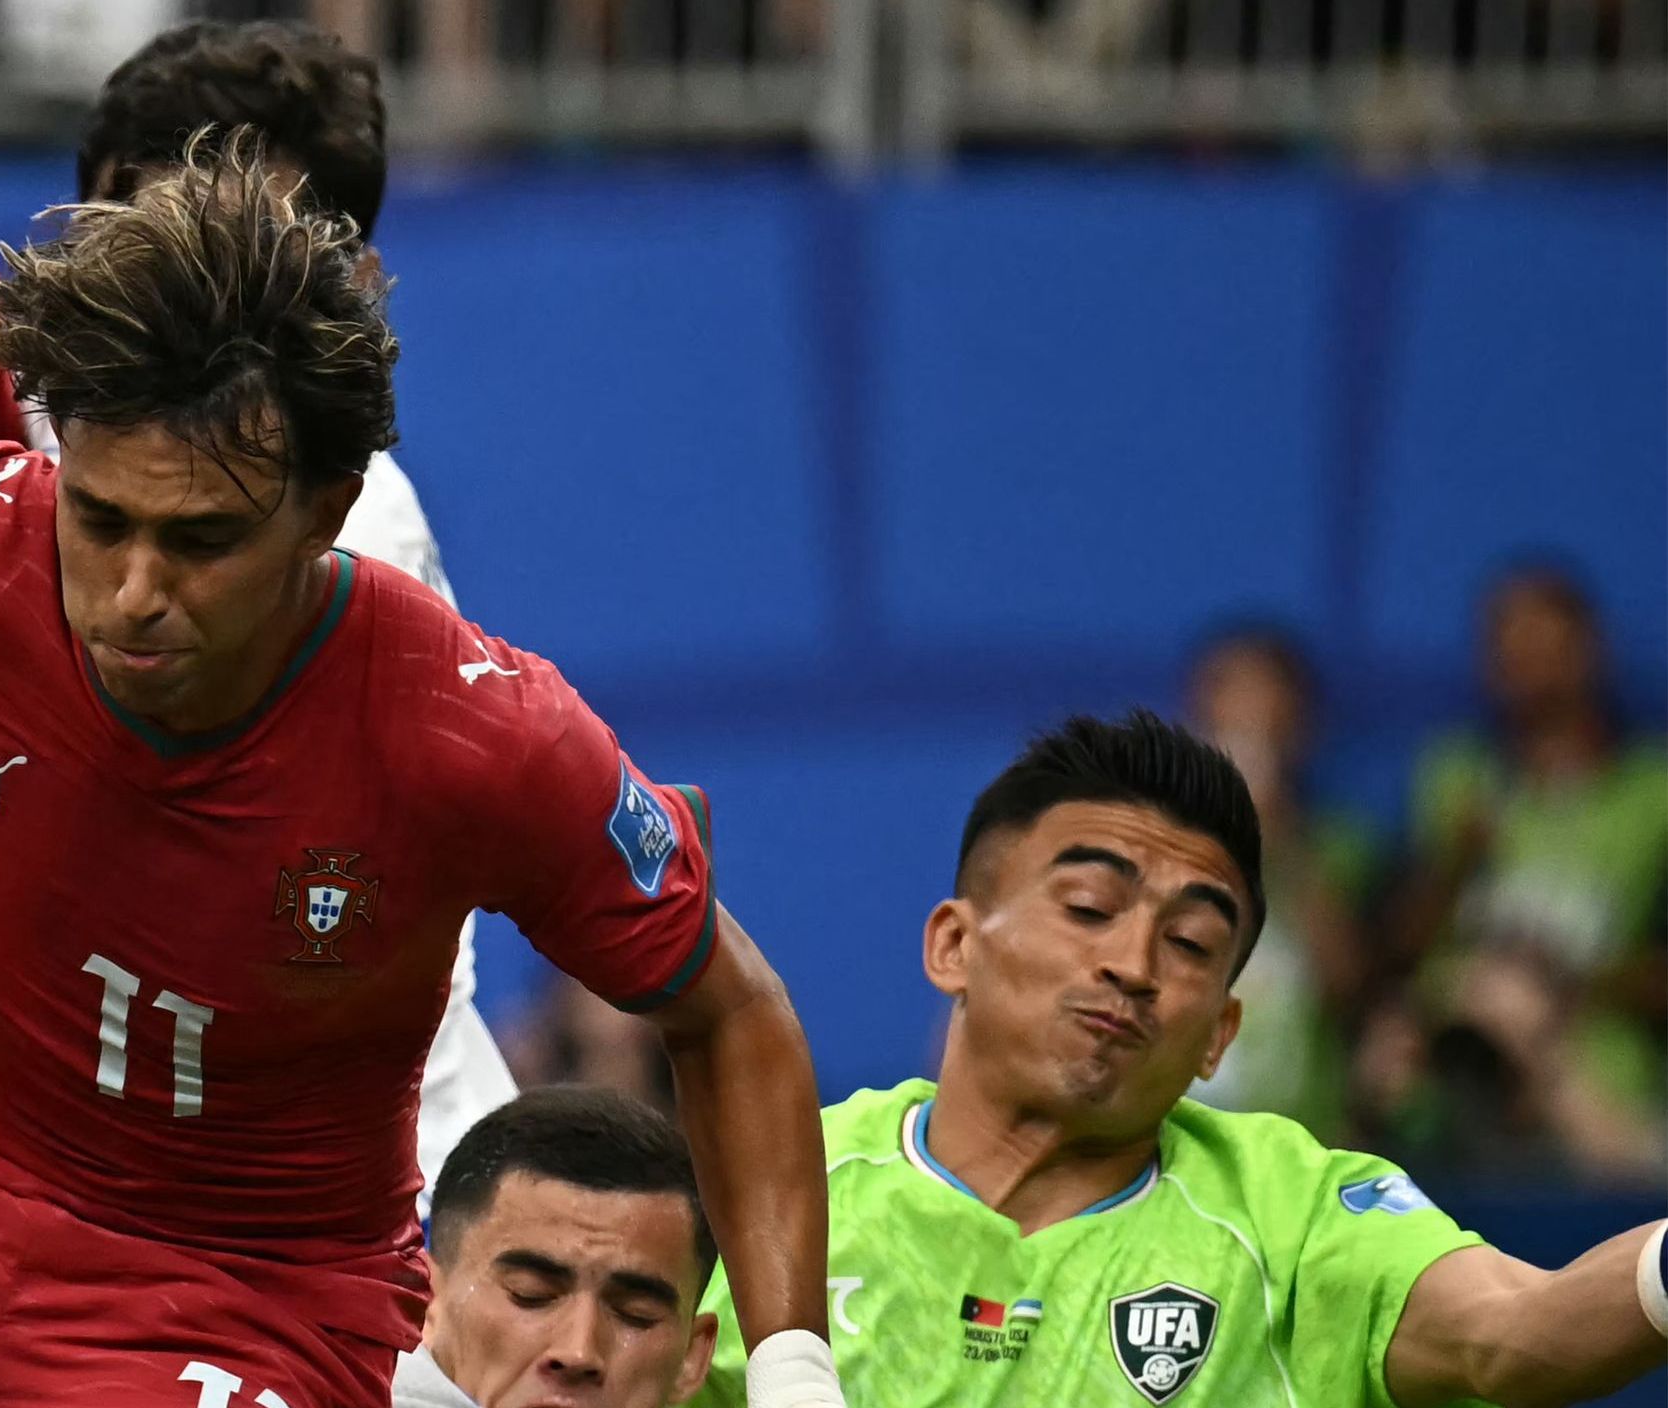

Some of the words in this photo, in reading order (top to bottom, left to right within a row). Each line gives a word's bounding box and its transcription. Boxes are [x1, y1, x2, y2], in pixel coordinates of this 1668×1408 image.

[81, 953, 214, 1118] 11
[1009, 1328, 1028, 1343] USA
[1127, 1307, 1201, 1350] UFA
